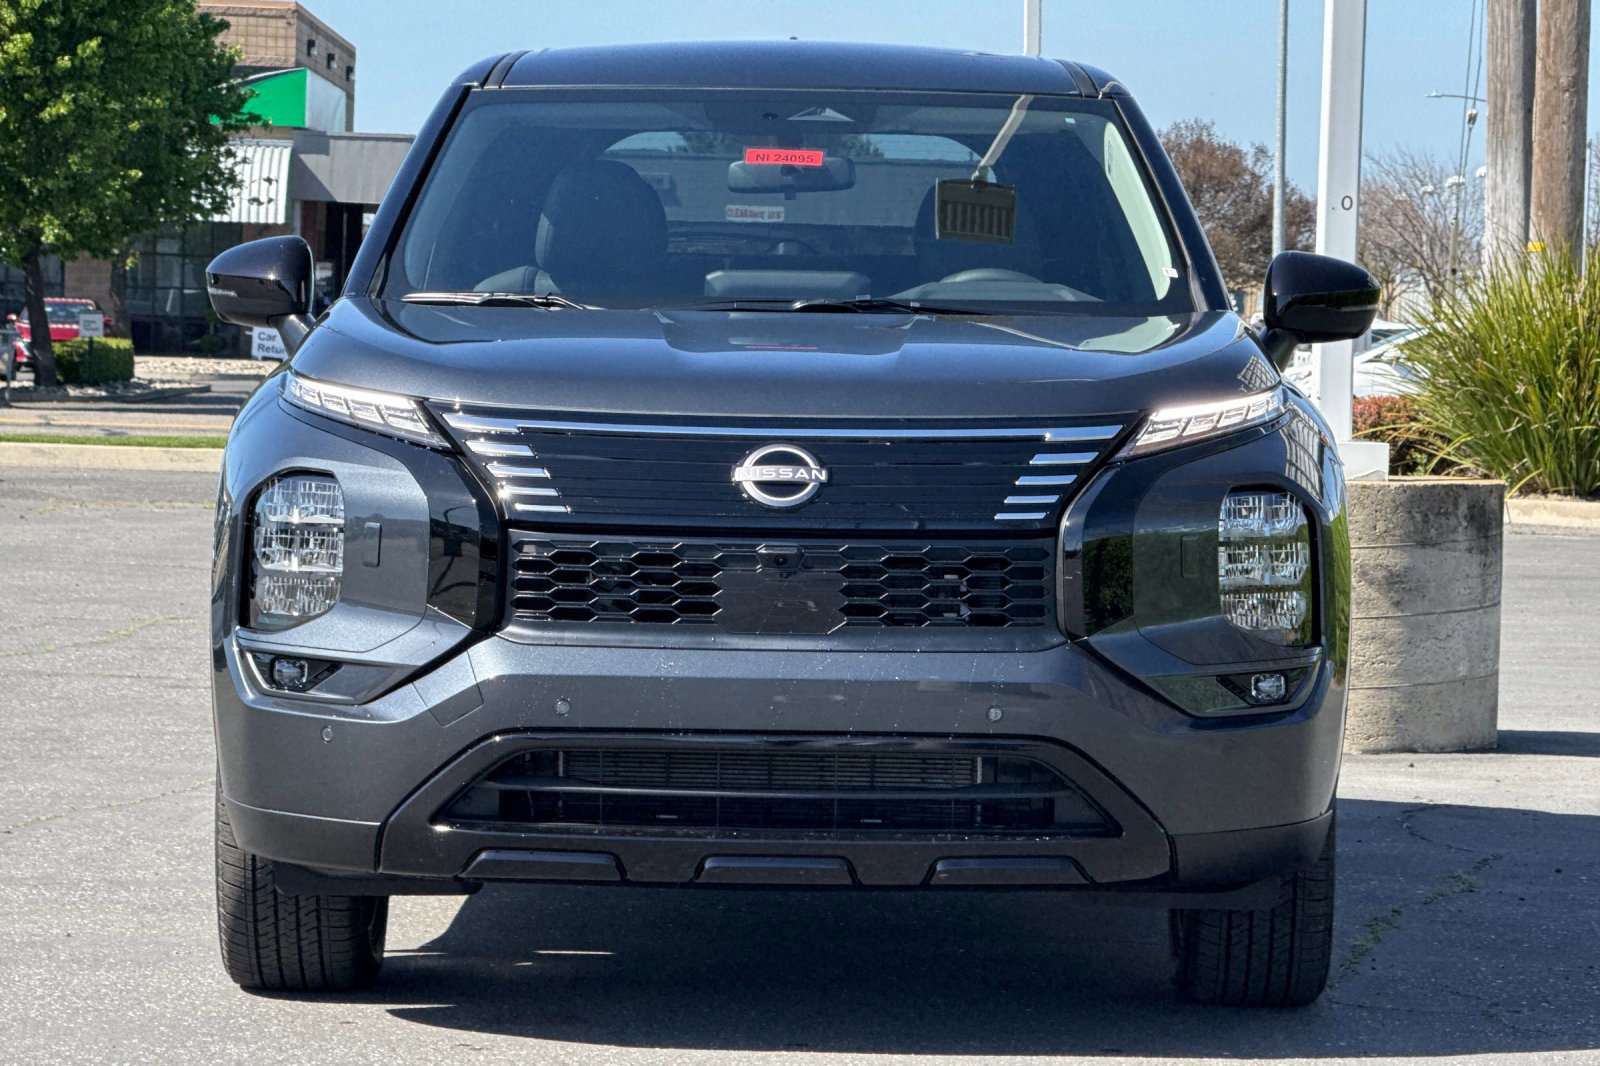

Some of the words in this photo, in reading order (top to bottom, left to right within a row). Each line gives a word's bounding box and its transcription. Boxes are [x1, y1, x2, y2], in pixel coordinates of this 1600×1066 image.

[755, 153, 770, 162] NI
[773, 154, 814, 163] 24095
[257, 331, 277, 342] Car
[739, 467, 826, 480] NISSAN
